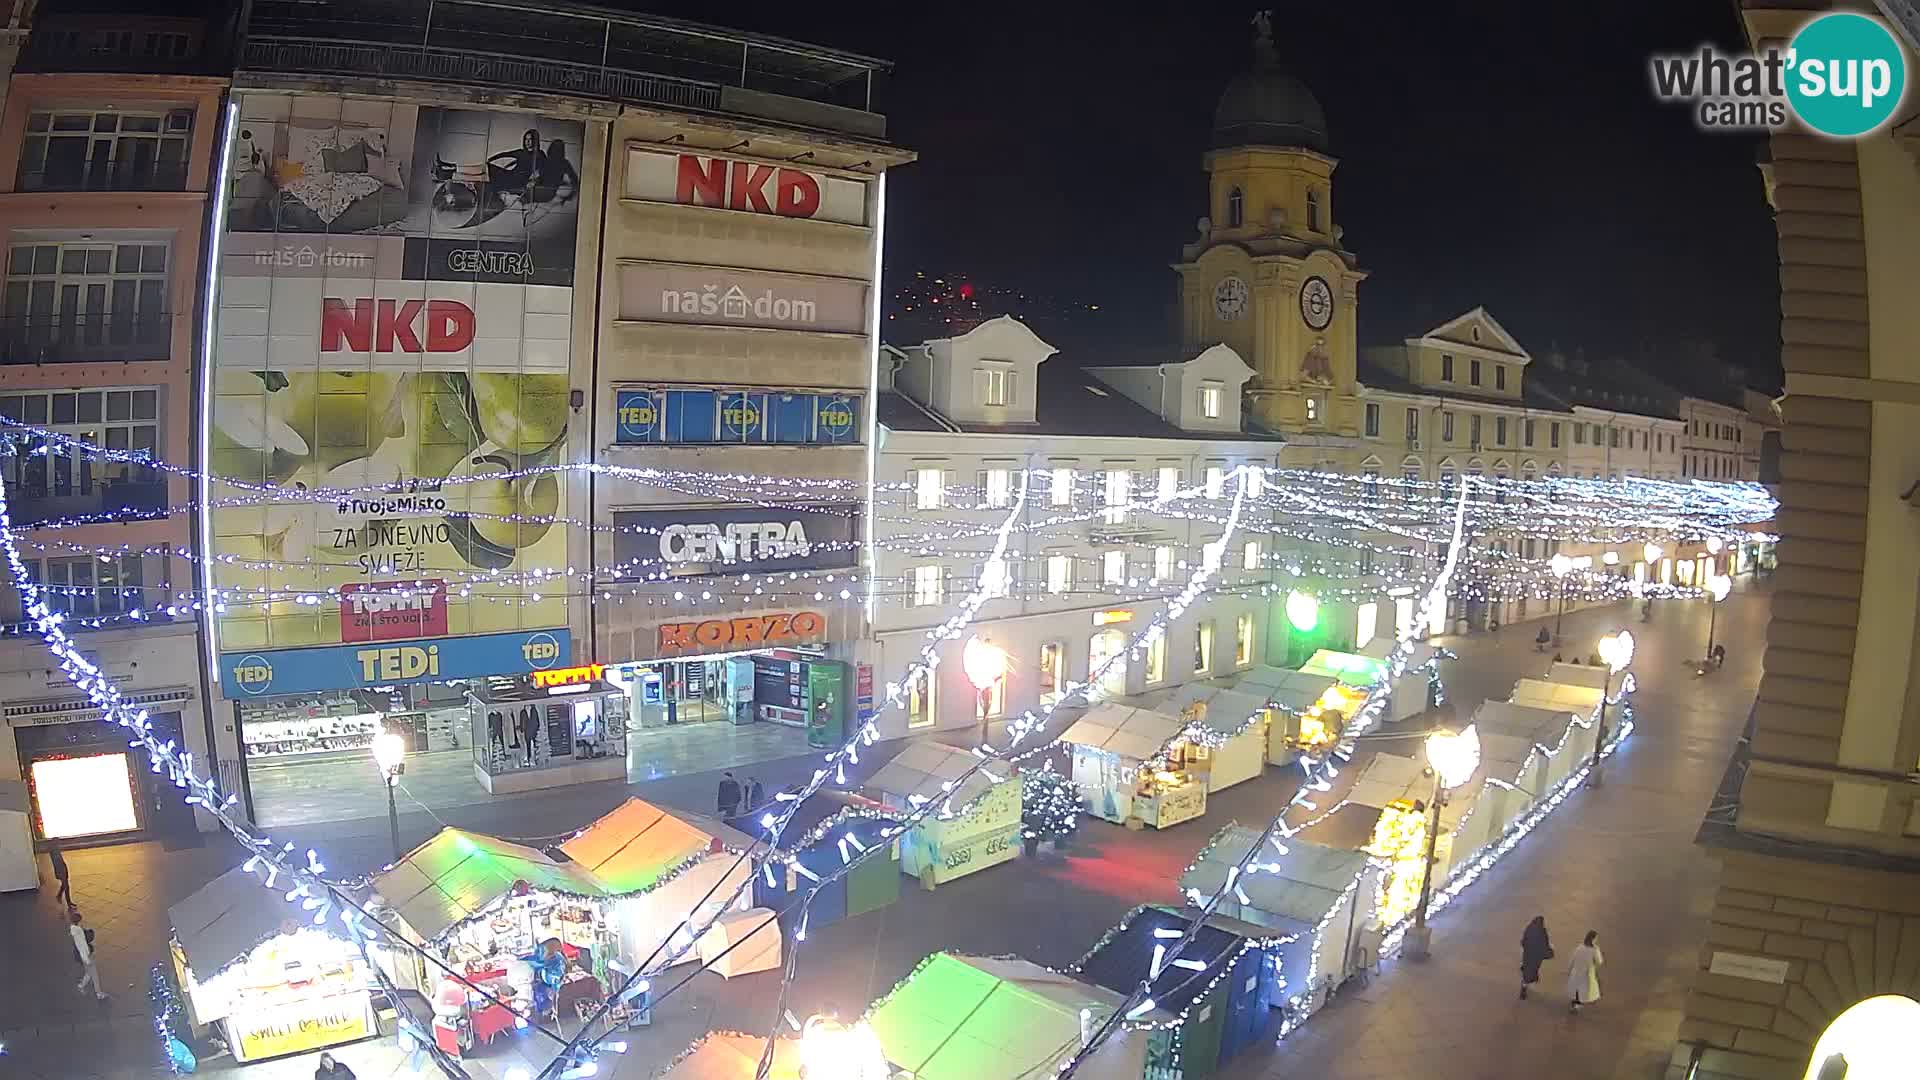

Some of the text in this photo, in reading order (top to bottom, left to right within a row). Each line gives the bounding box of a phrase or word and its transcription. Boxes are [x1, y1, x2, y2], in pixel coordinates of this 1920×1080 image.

[676, 154, 820, 218] NKD
[320, 245, 366, 269] dom
[448, 249, 535, 275] CENTRA
[661, 284, 816, 322] naš dom
[321, 298, 476, 353] NKD
[618, 407, 657, 424] TEDi
[723, 409, 760, 426] TEDi
[820, 410, 854, 427] TEDi
[333, 523, 450, 549] ZA DNEVNO
[659, 520, 810, 563] CENTRA
[360, 546, 425, 575] SVJEŽE
[659, 611, 825, 651] KORZO
[358, 644, 439, 681] TEDi
[522, 642, 559, 661] TEDi
[232, 664, 273, 682] TEDi
[532, 663, 604, 688] TOMMY
